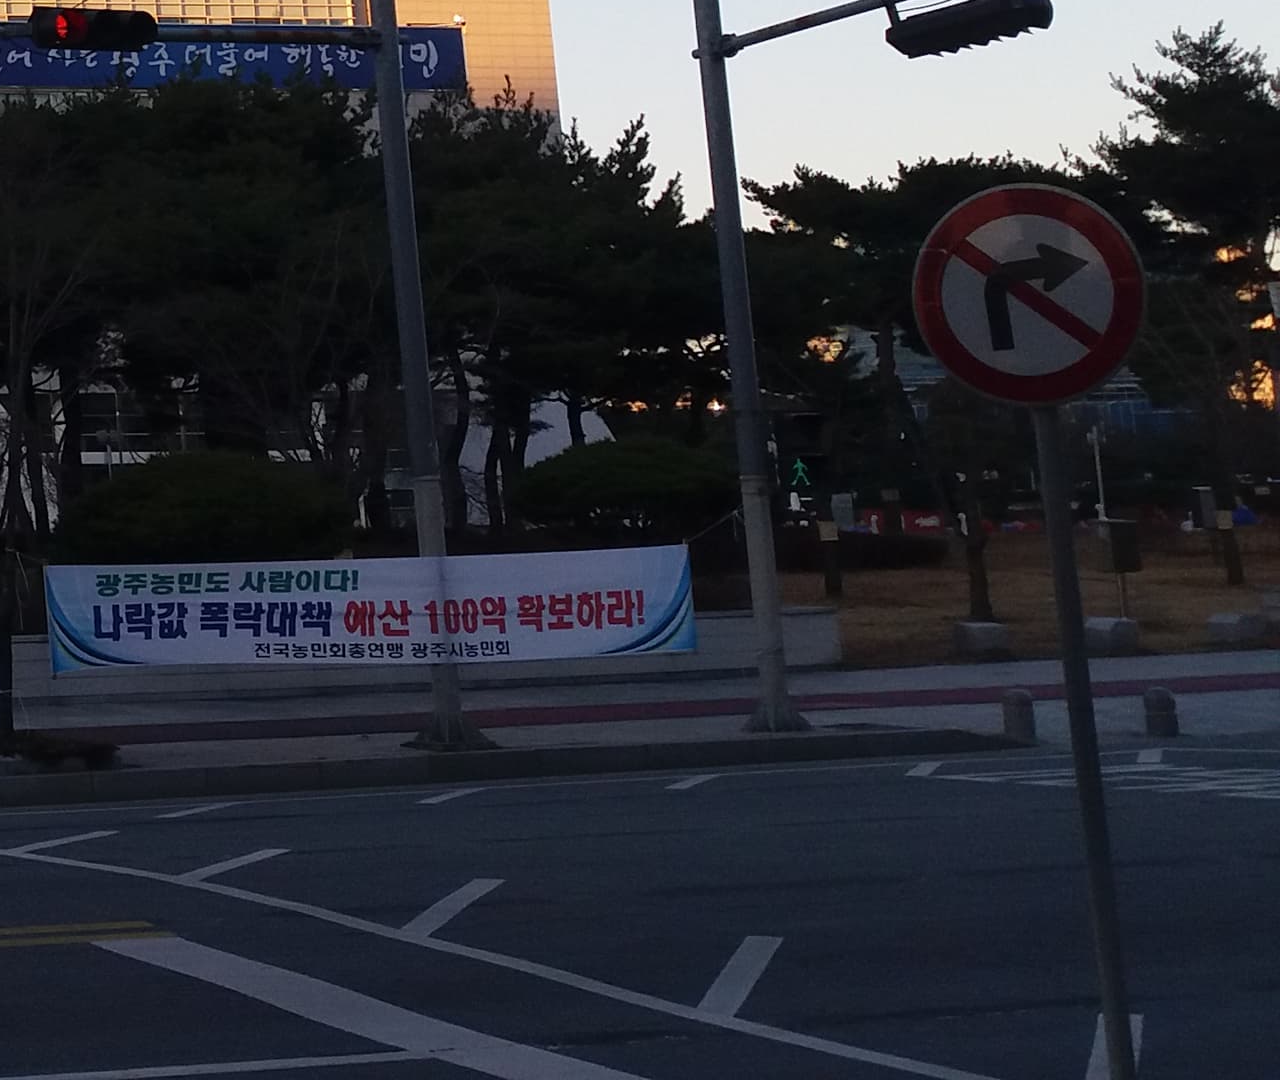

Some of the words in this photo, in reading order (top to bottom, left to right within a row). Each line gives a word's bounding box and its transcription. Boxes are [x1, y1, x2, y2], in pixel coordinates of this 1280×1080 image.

[94, 571, 230, 596] 광주농민도
[239, 568, 360, 594] 사람이다!
[93, 602, 188, 641] 나락값
[199, 601, 333, 638] 폭락대책
[343, 599, 410, 637] 예산
[425, 595, 507, 633] 100억
[517, 590, 645, 632] 확보하라!
[253, 641, 405, 659] 전국농민회총연맹
[410, 639, 511, 657] 광주시농민회
